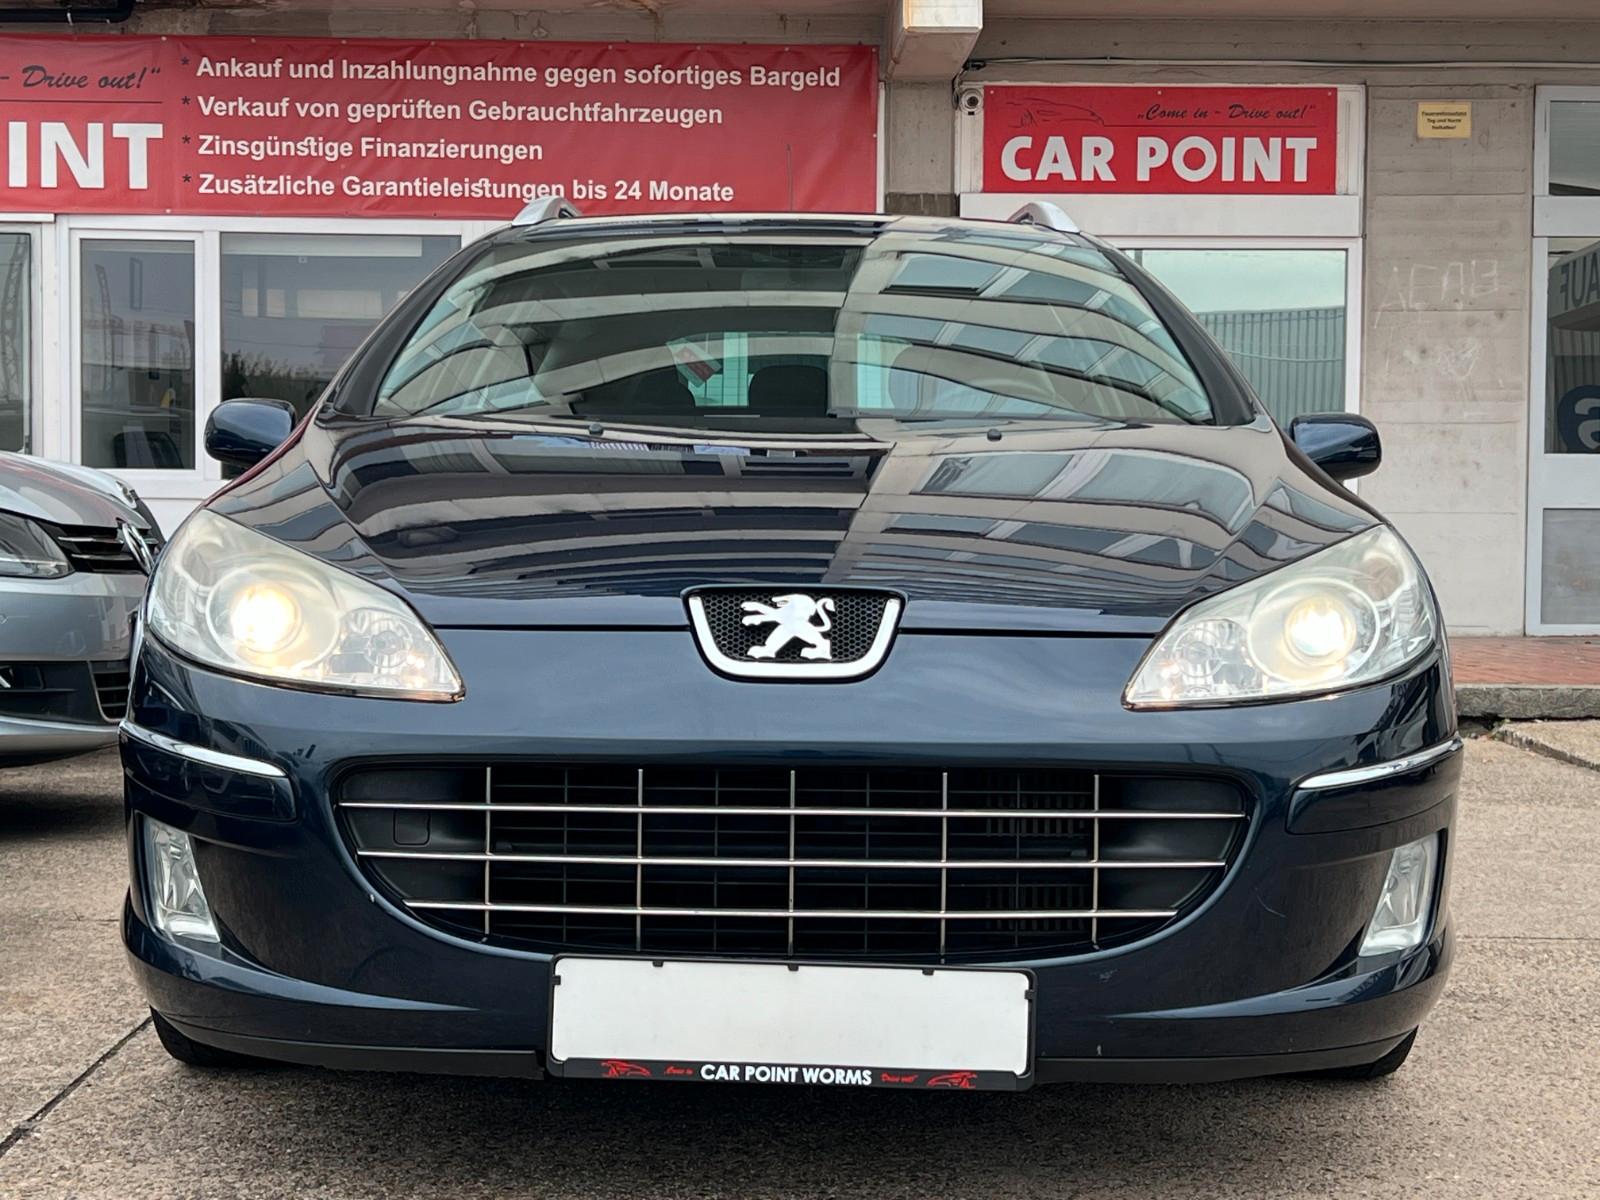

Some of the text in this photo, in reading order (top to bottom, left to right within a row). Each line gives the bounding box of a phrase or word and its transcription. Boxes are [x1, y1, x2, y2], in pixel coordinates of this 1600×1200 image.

[22, 64, 89, 88] Drive
[196, 57, 840, 91] Ankauf und Inzahlungnahme gegen sofortiges Bargeld
[197, 95, 723, 129] Verkauf von geprüften Gebrauchtfahrzeugen
[1193, 107, 1208, 119] in
[1228, 103, 1270, 119] Drive
[197, 134, 543, 165] Zinsgünstige Finanzierungen
[1001, 136, 1317, 182] CAR POINT
[198, 173, 734, 203] Zusätzliche Garantieleistungen bis 24 Monate
[700, 1064, 740, 1081] CAR
[744, 1065, 799, 1083] POINT
[801, 1067, 872, 1086] WORMS
